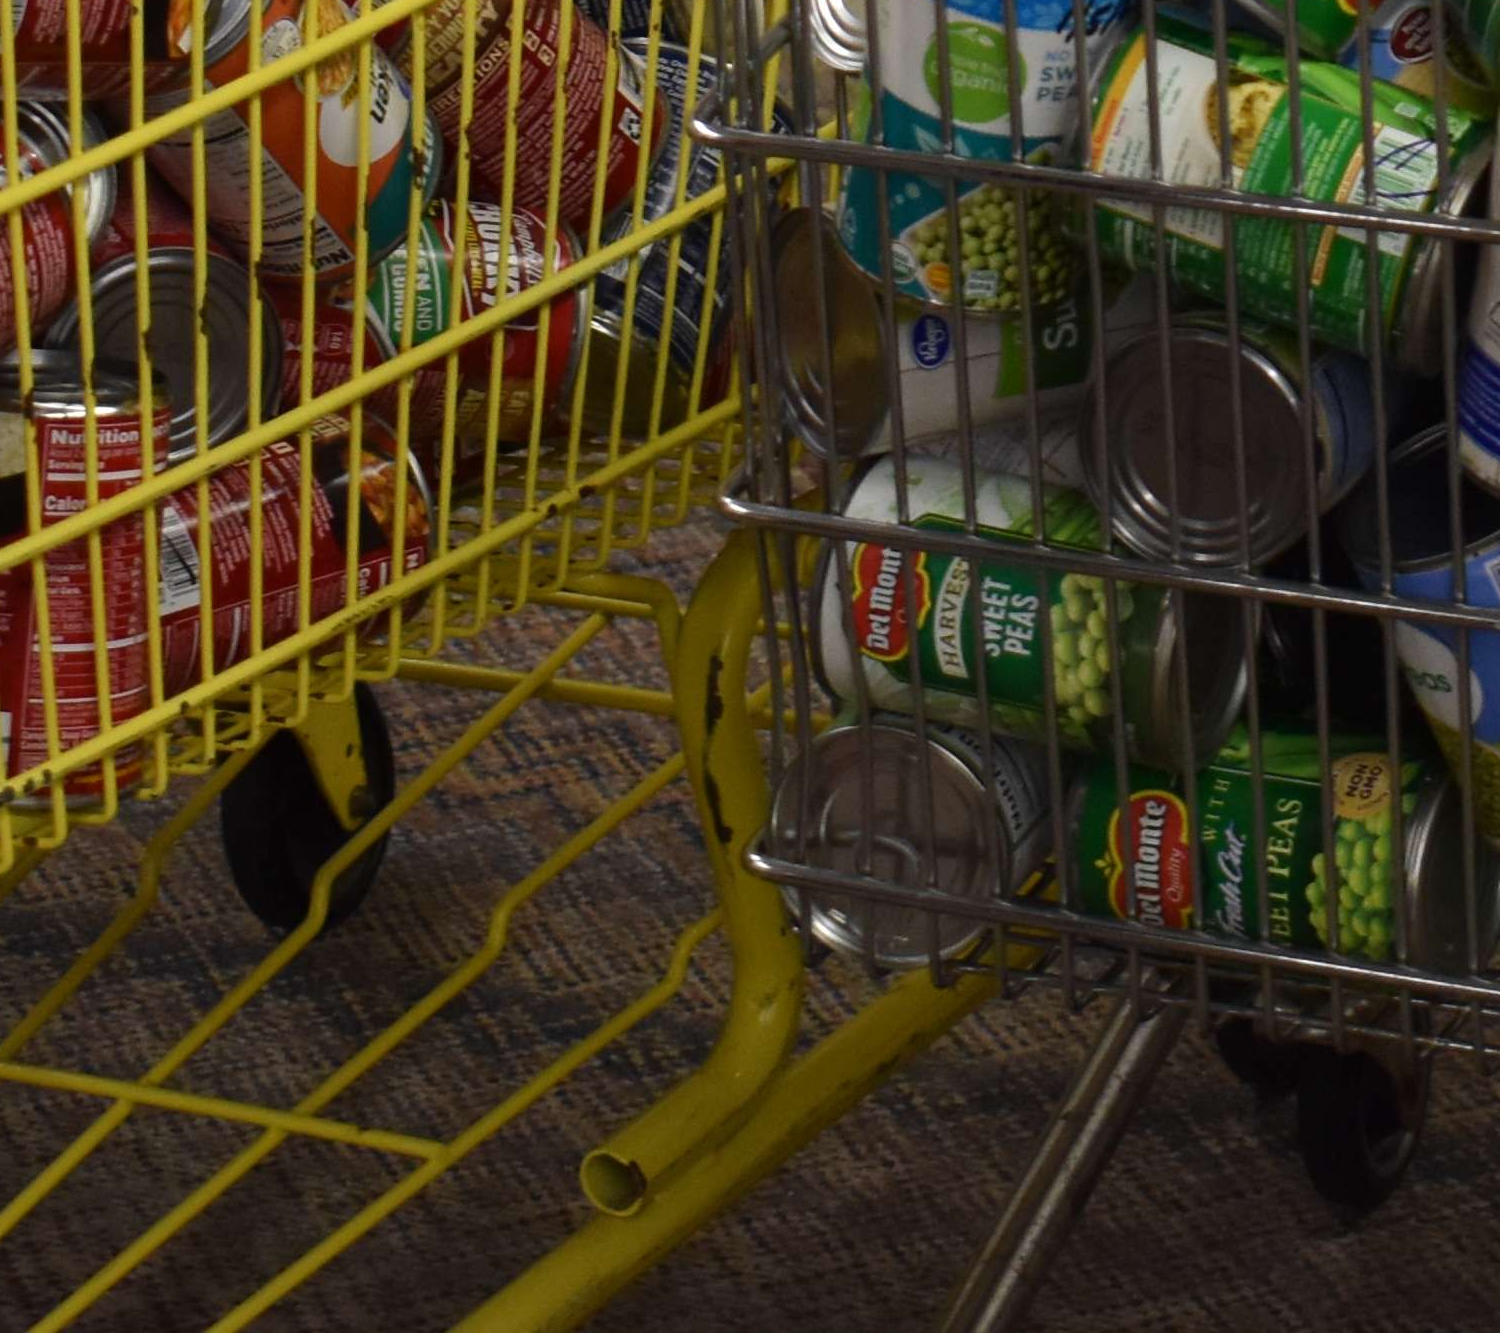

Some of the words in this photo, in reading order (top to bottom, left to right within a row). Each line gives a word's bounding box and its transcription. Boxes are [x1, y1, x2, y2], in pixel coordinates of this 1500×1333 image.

[416, 295, 433, 332] AND
[874, 546, 901, 617] Mont
[865, 618, 892, 653] Del
[943, 559, 971, 678] HARVES
[1004, 593, 1040, 658] PEAS
[1202, 776, 1232, 843] WITH
[1345, 761, 1369, 802] NON
[1357, 758, 1385, 801] GMO
[1140, 797, 1169, 886] Monte
[1266, 796, 1303, 887] PEAS
